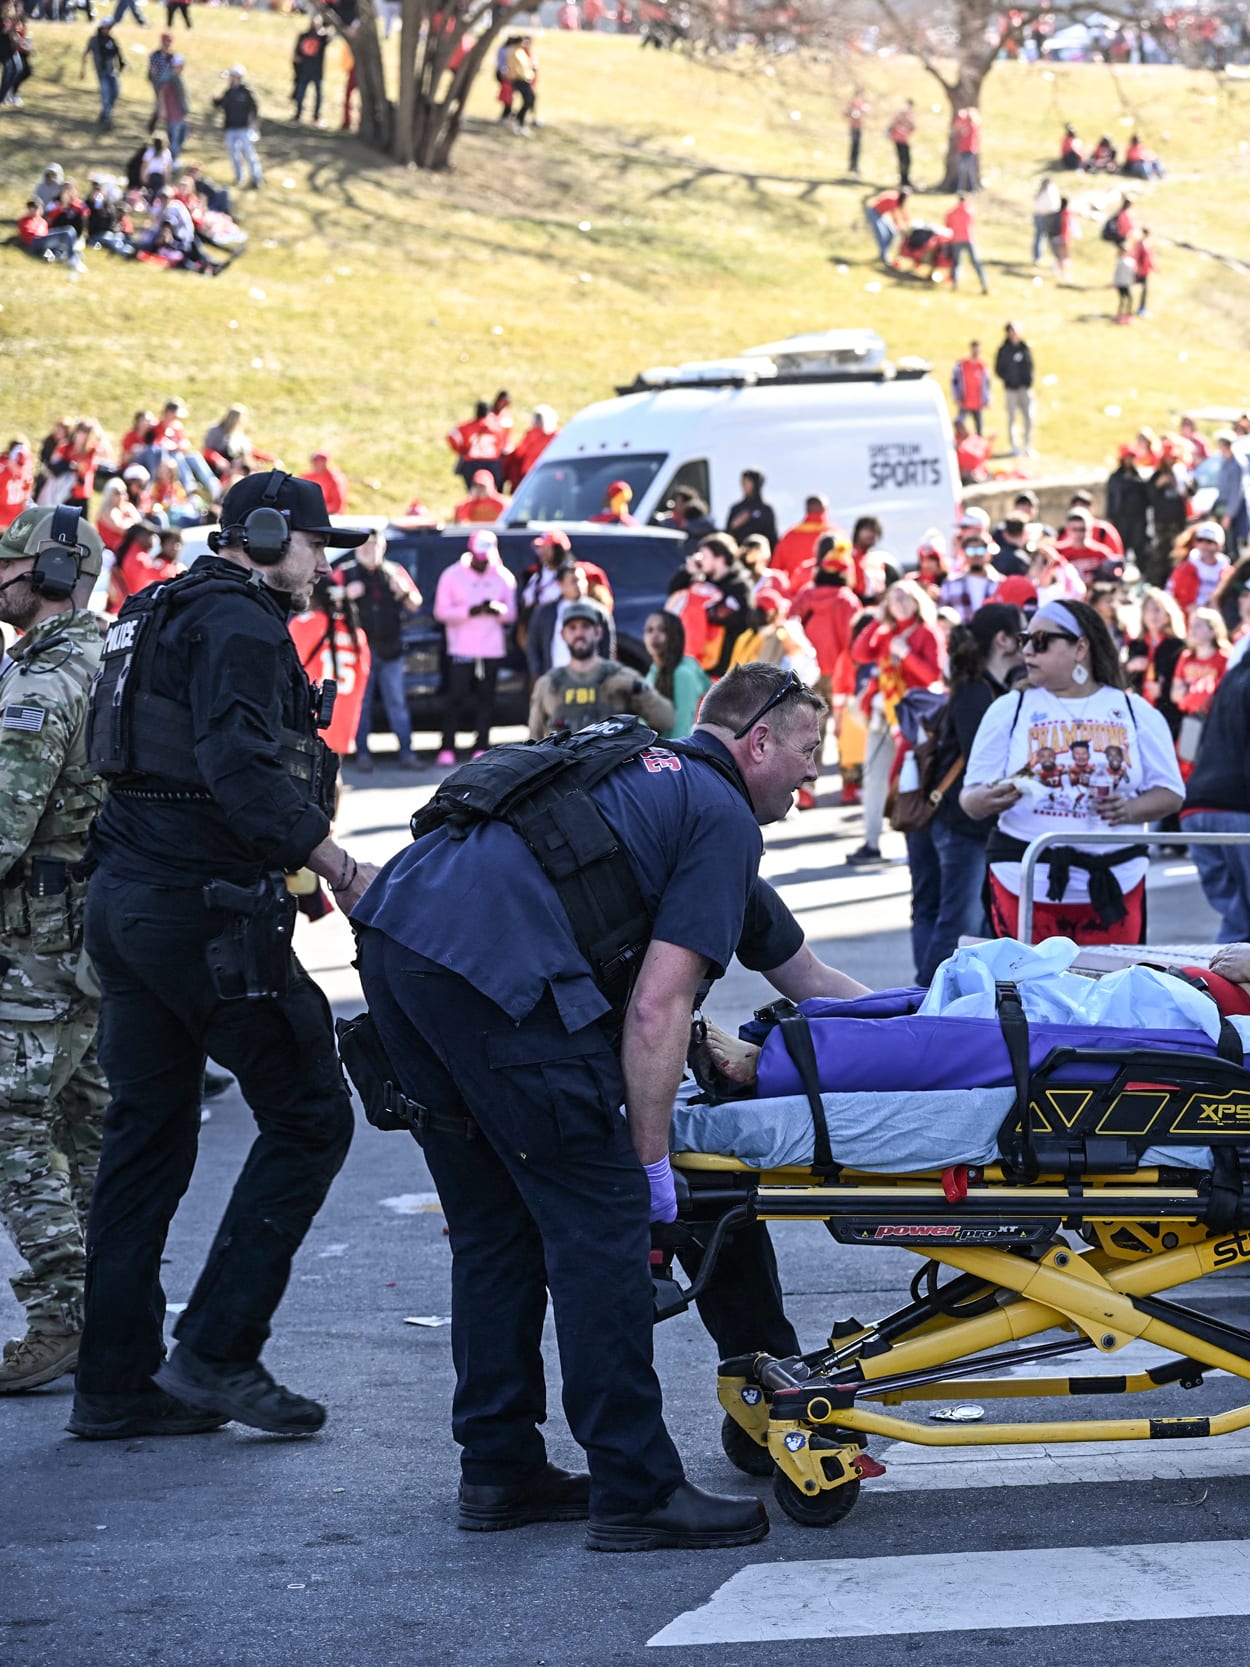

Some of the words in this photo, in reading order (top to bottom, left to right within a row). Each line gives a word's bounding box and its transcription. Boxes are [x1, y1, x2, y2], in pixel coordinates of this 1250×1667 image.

[869, 458, 941, 490] SPORTS
[103, 620, 138, 654] POLICE
[565, 687, 596, 705] FBI
